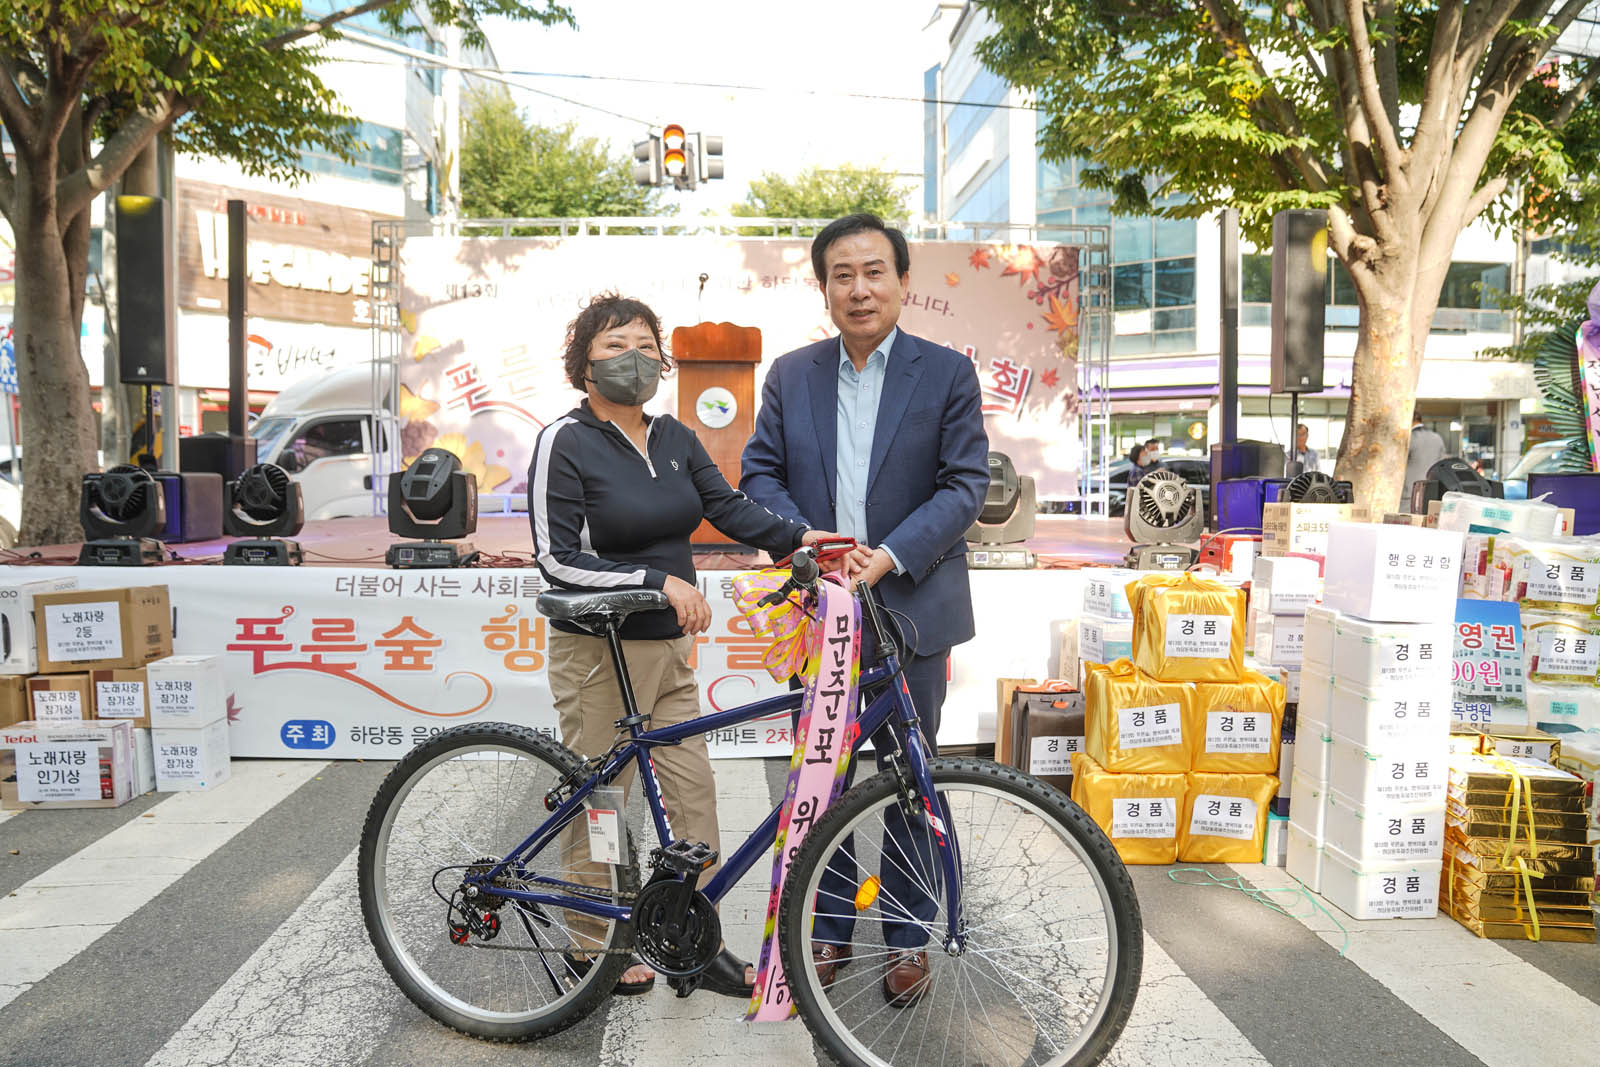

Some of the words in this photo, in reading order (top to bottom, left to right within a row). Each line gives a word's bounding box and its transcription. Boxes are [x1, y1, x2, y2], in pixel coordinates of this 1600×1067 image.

[335, 575, 403, 597] 더불어
[414, 575, 461, 597] 사는
[472, 575, 543, 598] 사회를
[62, 610, 104, 624] 노래자랑
[75, 626, 92, 638] 2등
[226, 605, 443, 676] 푸른숲
[102, 683, 139, 694] 노래자랑
[155, 681, 192, 692] 노래자랑
[39, 691, 76, 702] 노래자랑
[107, 696, 135, 706] 참가상
[160, 694, 188, 705] 참가상
[45, 705, 73, 715] 참가상
[4, 735, 39, 744] Tefal
[286, 724, 329, 745] 주최
[350, 726, 405, 746] 하당동
[766, 728, 794, 745] 2차
[160, 746, 198, 757] 노래자랑
[28, 750, 87, 766] 노래자랑
[167, 758, 194, 769] 참가상
[37, 770, 80, 785] 인기상
